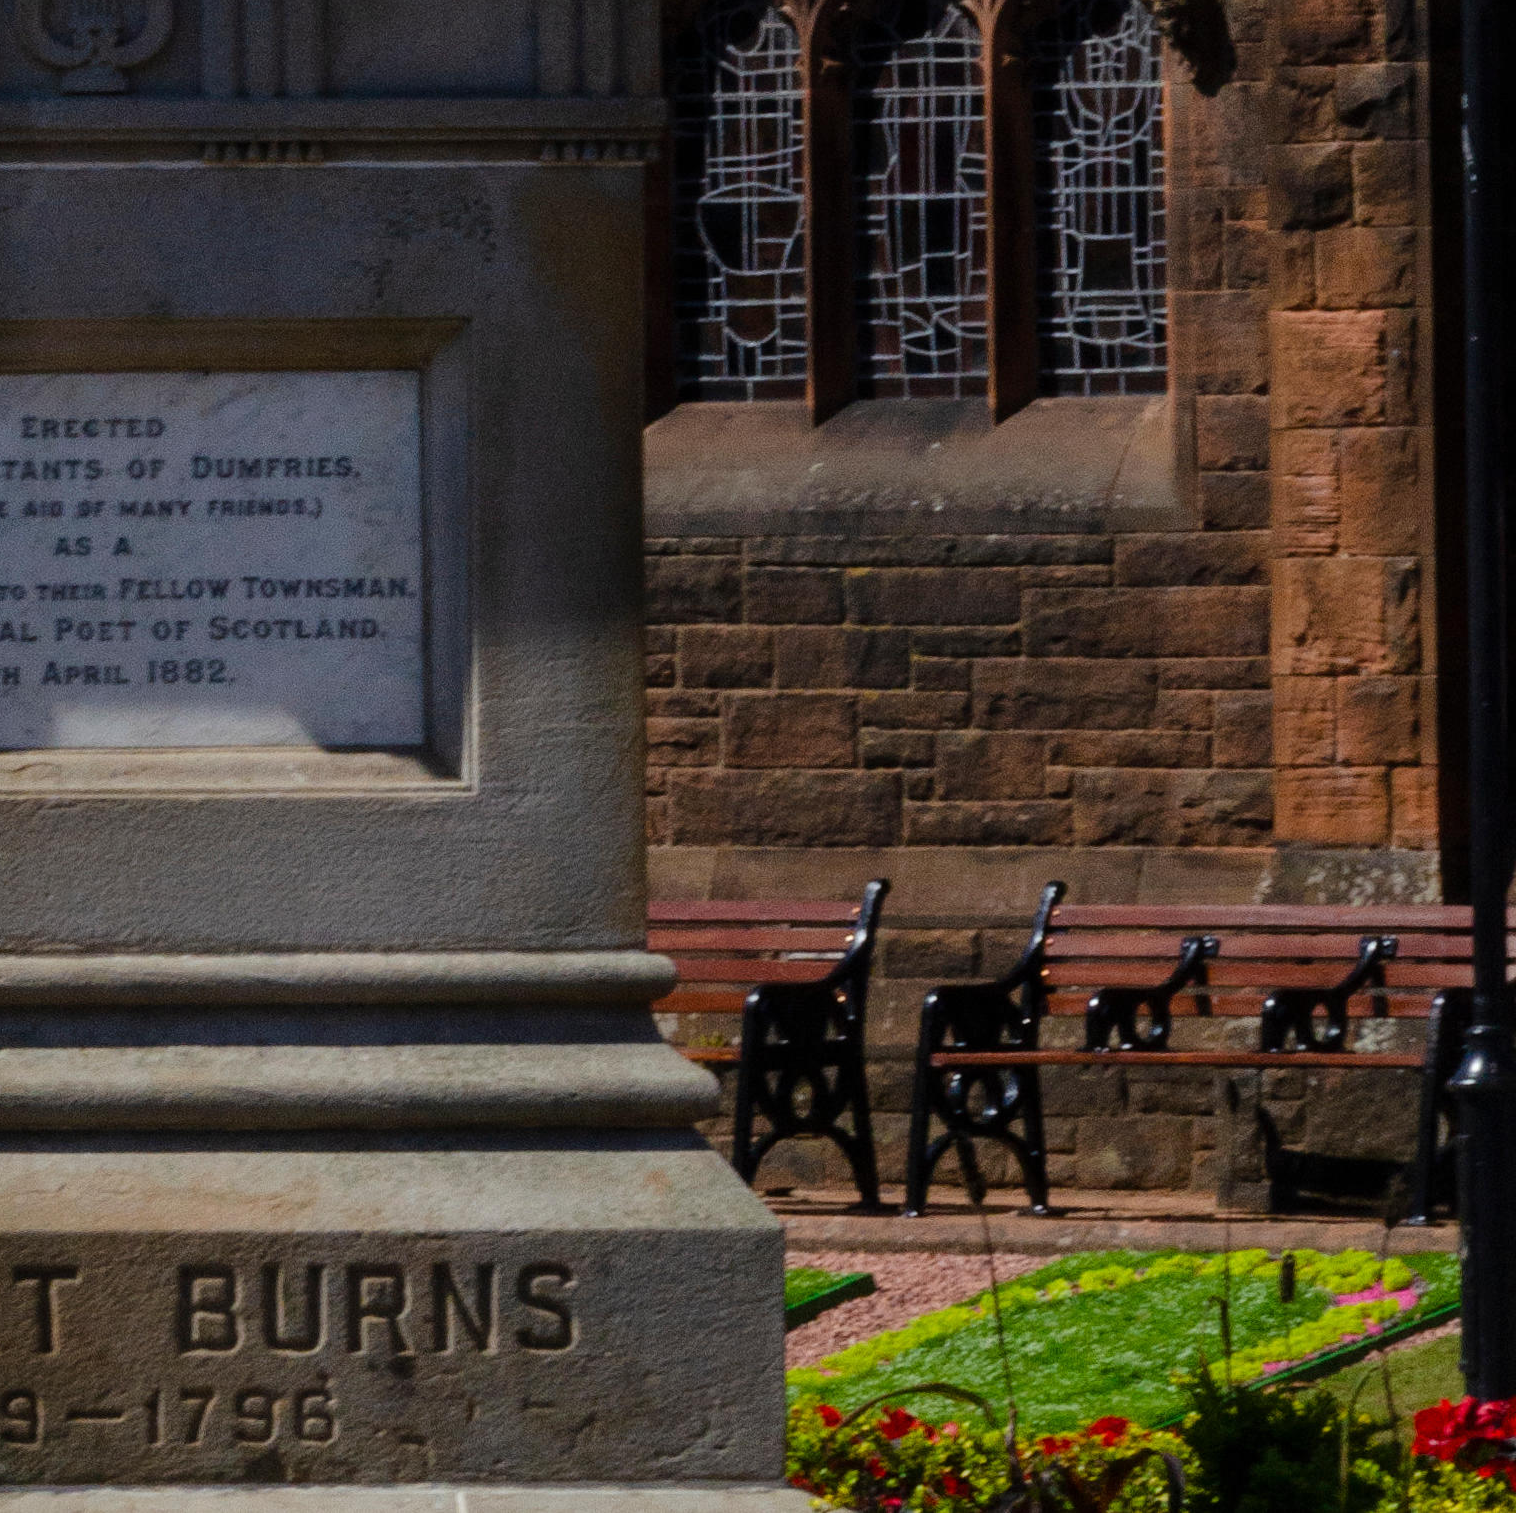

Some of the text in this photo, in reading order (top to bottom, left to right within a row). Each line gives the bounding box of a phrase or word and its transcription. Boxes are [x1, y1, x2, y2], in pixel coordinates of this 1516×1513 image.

[19, 414, 168, 441] ERECTED
[124, 456, 167, 482] OF
[20, 499, 65, 520] AID
[74, 498, 107, 521] OF
[116, 498, 194, 521] MANY
[51, 534, 135, 559] AS A
[33, 581, 108, 603] THEIR
[116, 576, 233, 603] FELLOW
[53, 615, 139, 643] POET
[149, 618, 192, 643] OF
[39, 659, 133, 689] APRIL
[179, 1260, 582, 1357] BURNS
